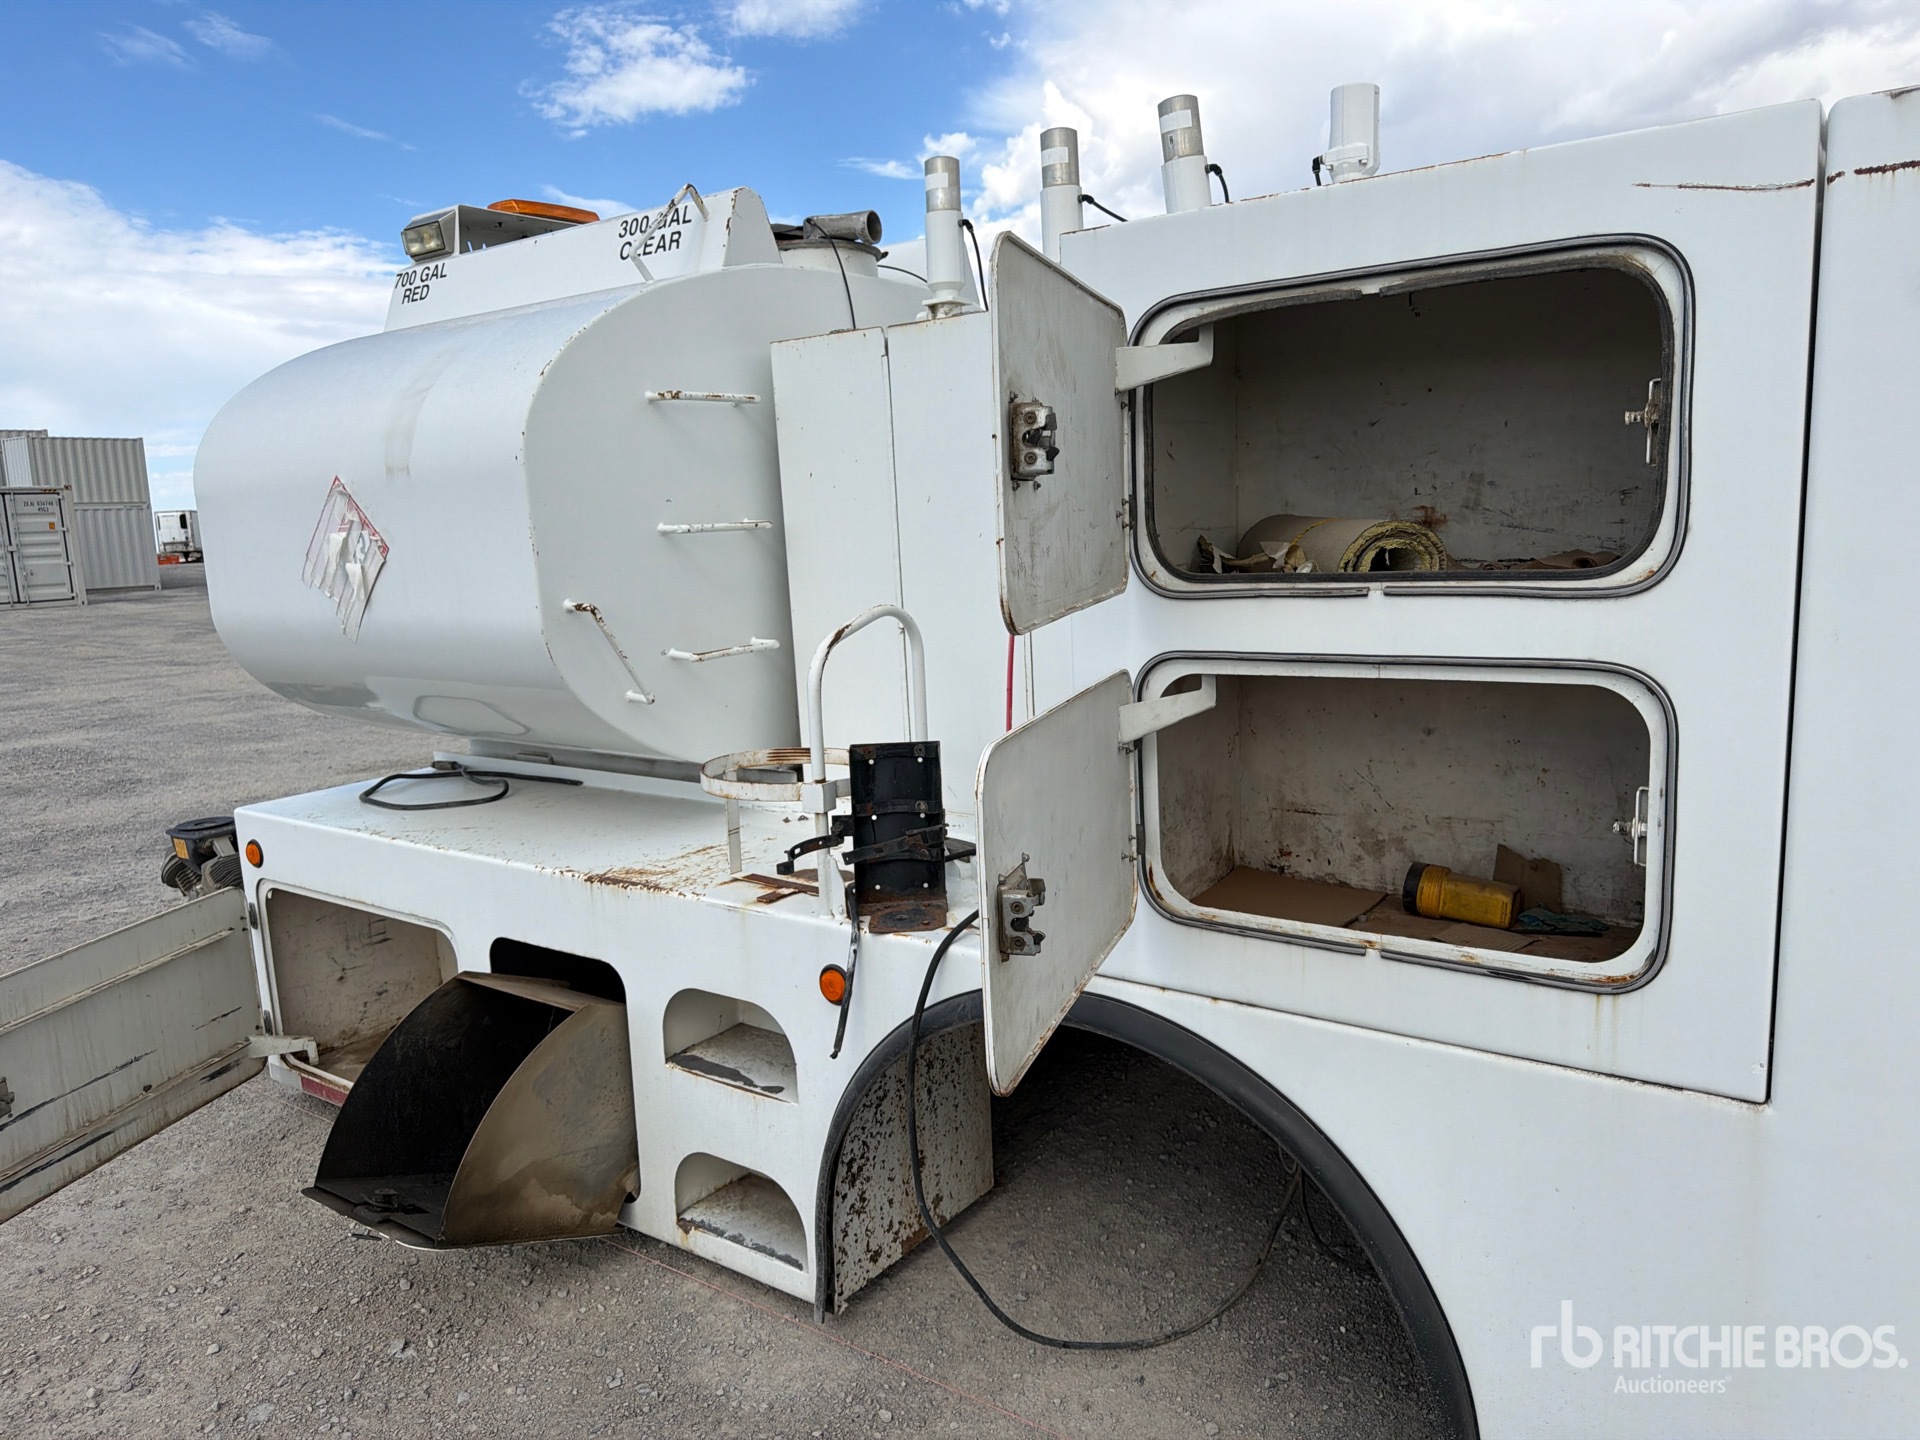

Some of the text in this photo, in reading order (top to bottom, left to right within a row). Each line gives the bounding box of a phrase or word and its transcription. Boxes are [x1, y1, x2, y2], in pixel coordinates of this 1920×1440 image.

[618, 214, 650, 238] 300
[619, 230, 682, 261] CEAR
[394, 262, 448, 289] 700 GAL
[401, 284, 430, 305] RED
